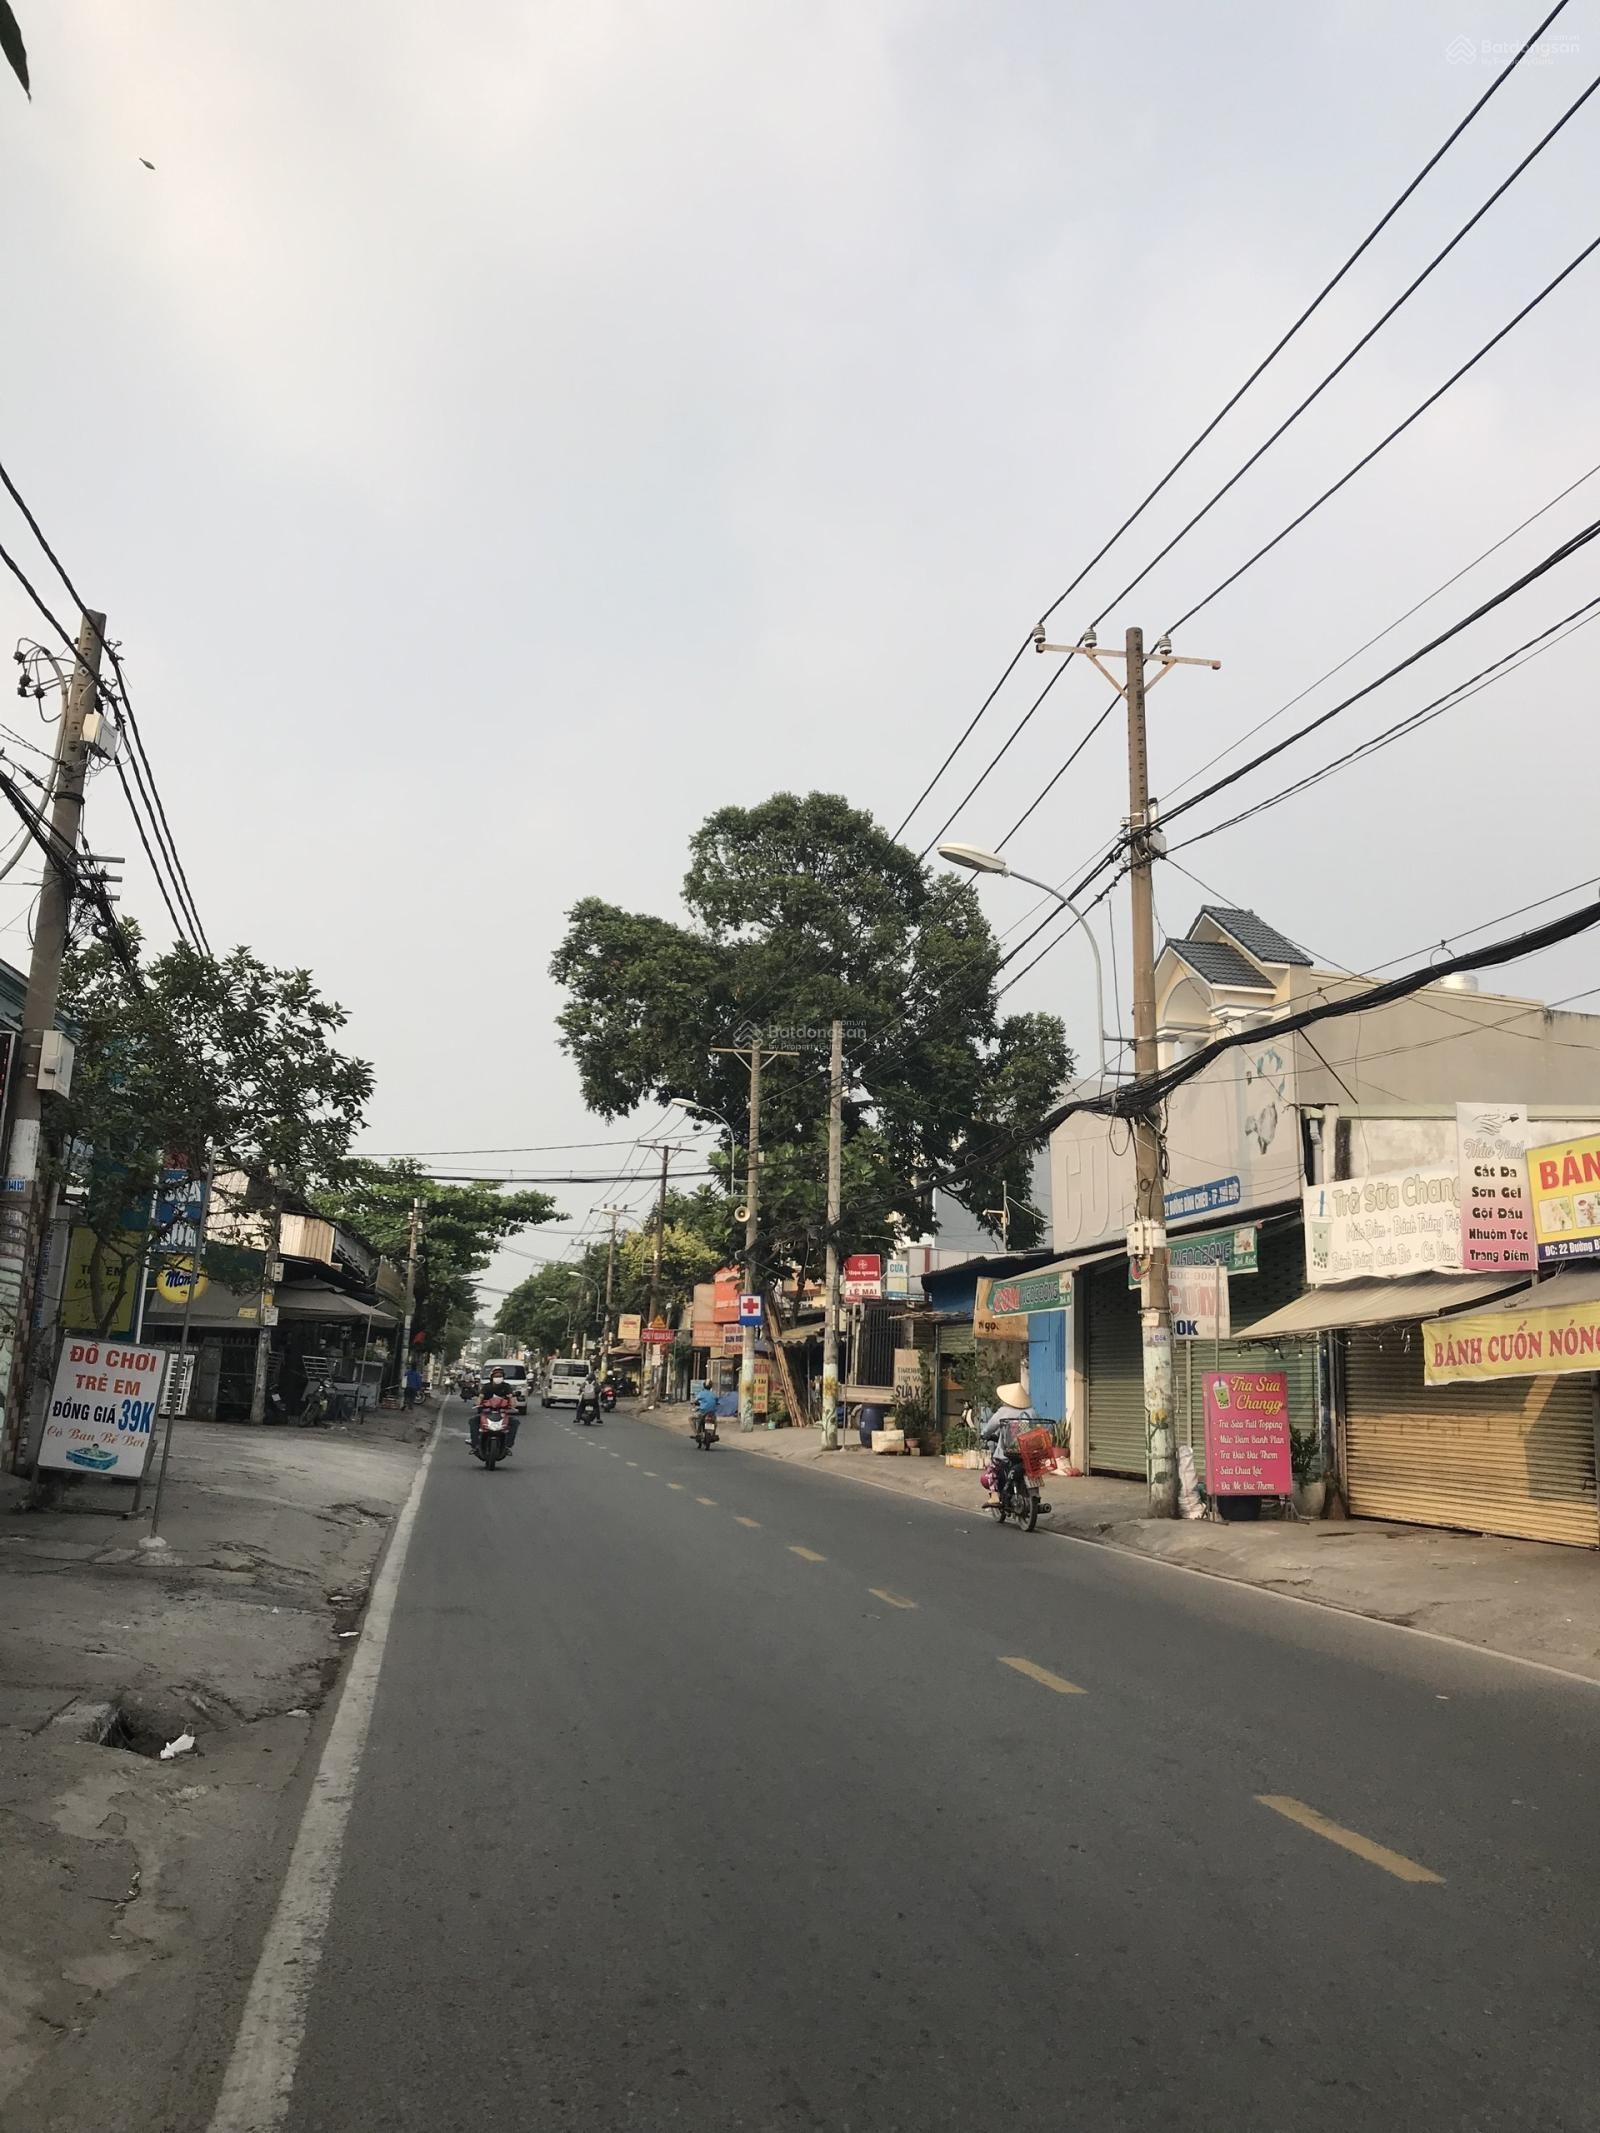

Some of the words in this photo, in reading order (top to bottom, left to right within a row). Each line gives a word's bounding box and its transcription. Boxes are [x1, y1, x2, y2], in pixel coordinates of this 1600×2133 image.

[1332, 1187, 1361, 1217] Trà
[1363, 1182, 1400, 1213] Sữa
[1472, 1186, 1495, 1198] Sơn
[1501, 1187, 1521, 1198] Gel
[1470, 1249, 1499, 1263] Trang
[1558, 1243, 1569, 1254] 22
[1433, 1334, 1483, 1368] BÁNH
[1488, 1320, 1543, 1362] CUỐN
[69, 1343, 100, 1365] ĐỒ
[105, 1350, 157, 1372] CHƠI
[75, 1372, 109, 1392] TRẺ
[113, 1379, 141, 1397] EM
[93, 1403, 117, 1425] GIÁ
[118, 1399, 155, 1434] 39K
[1258, 1419, 1283, 1431] Topping
